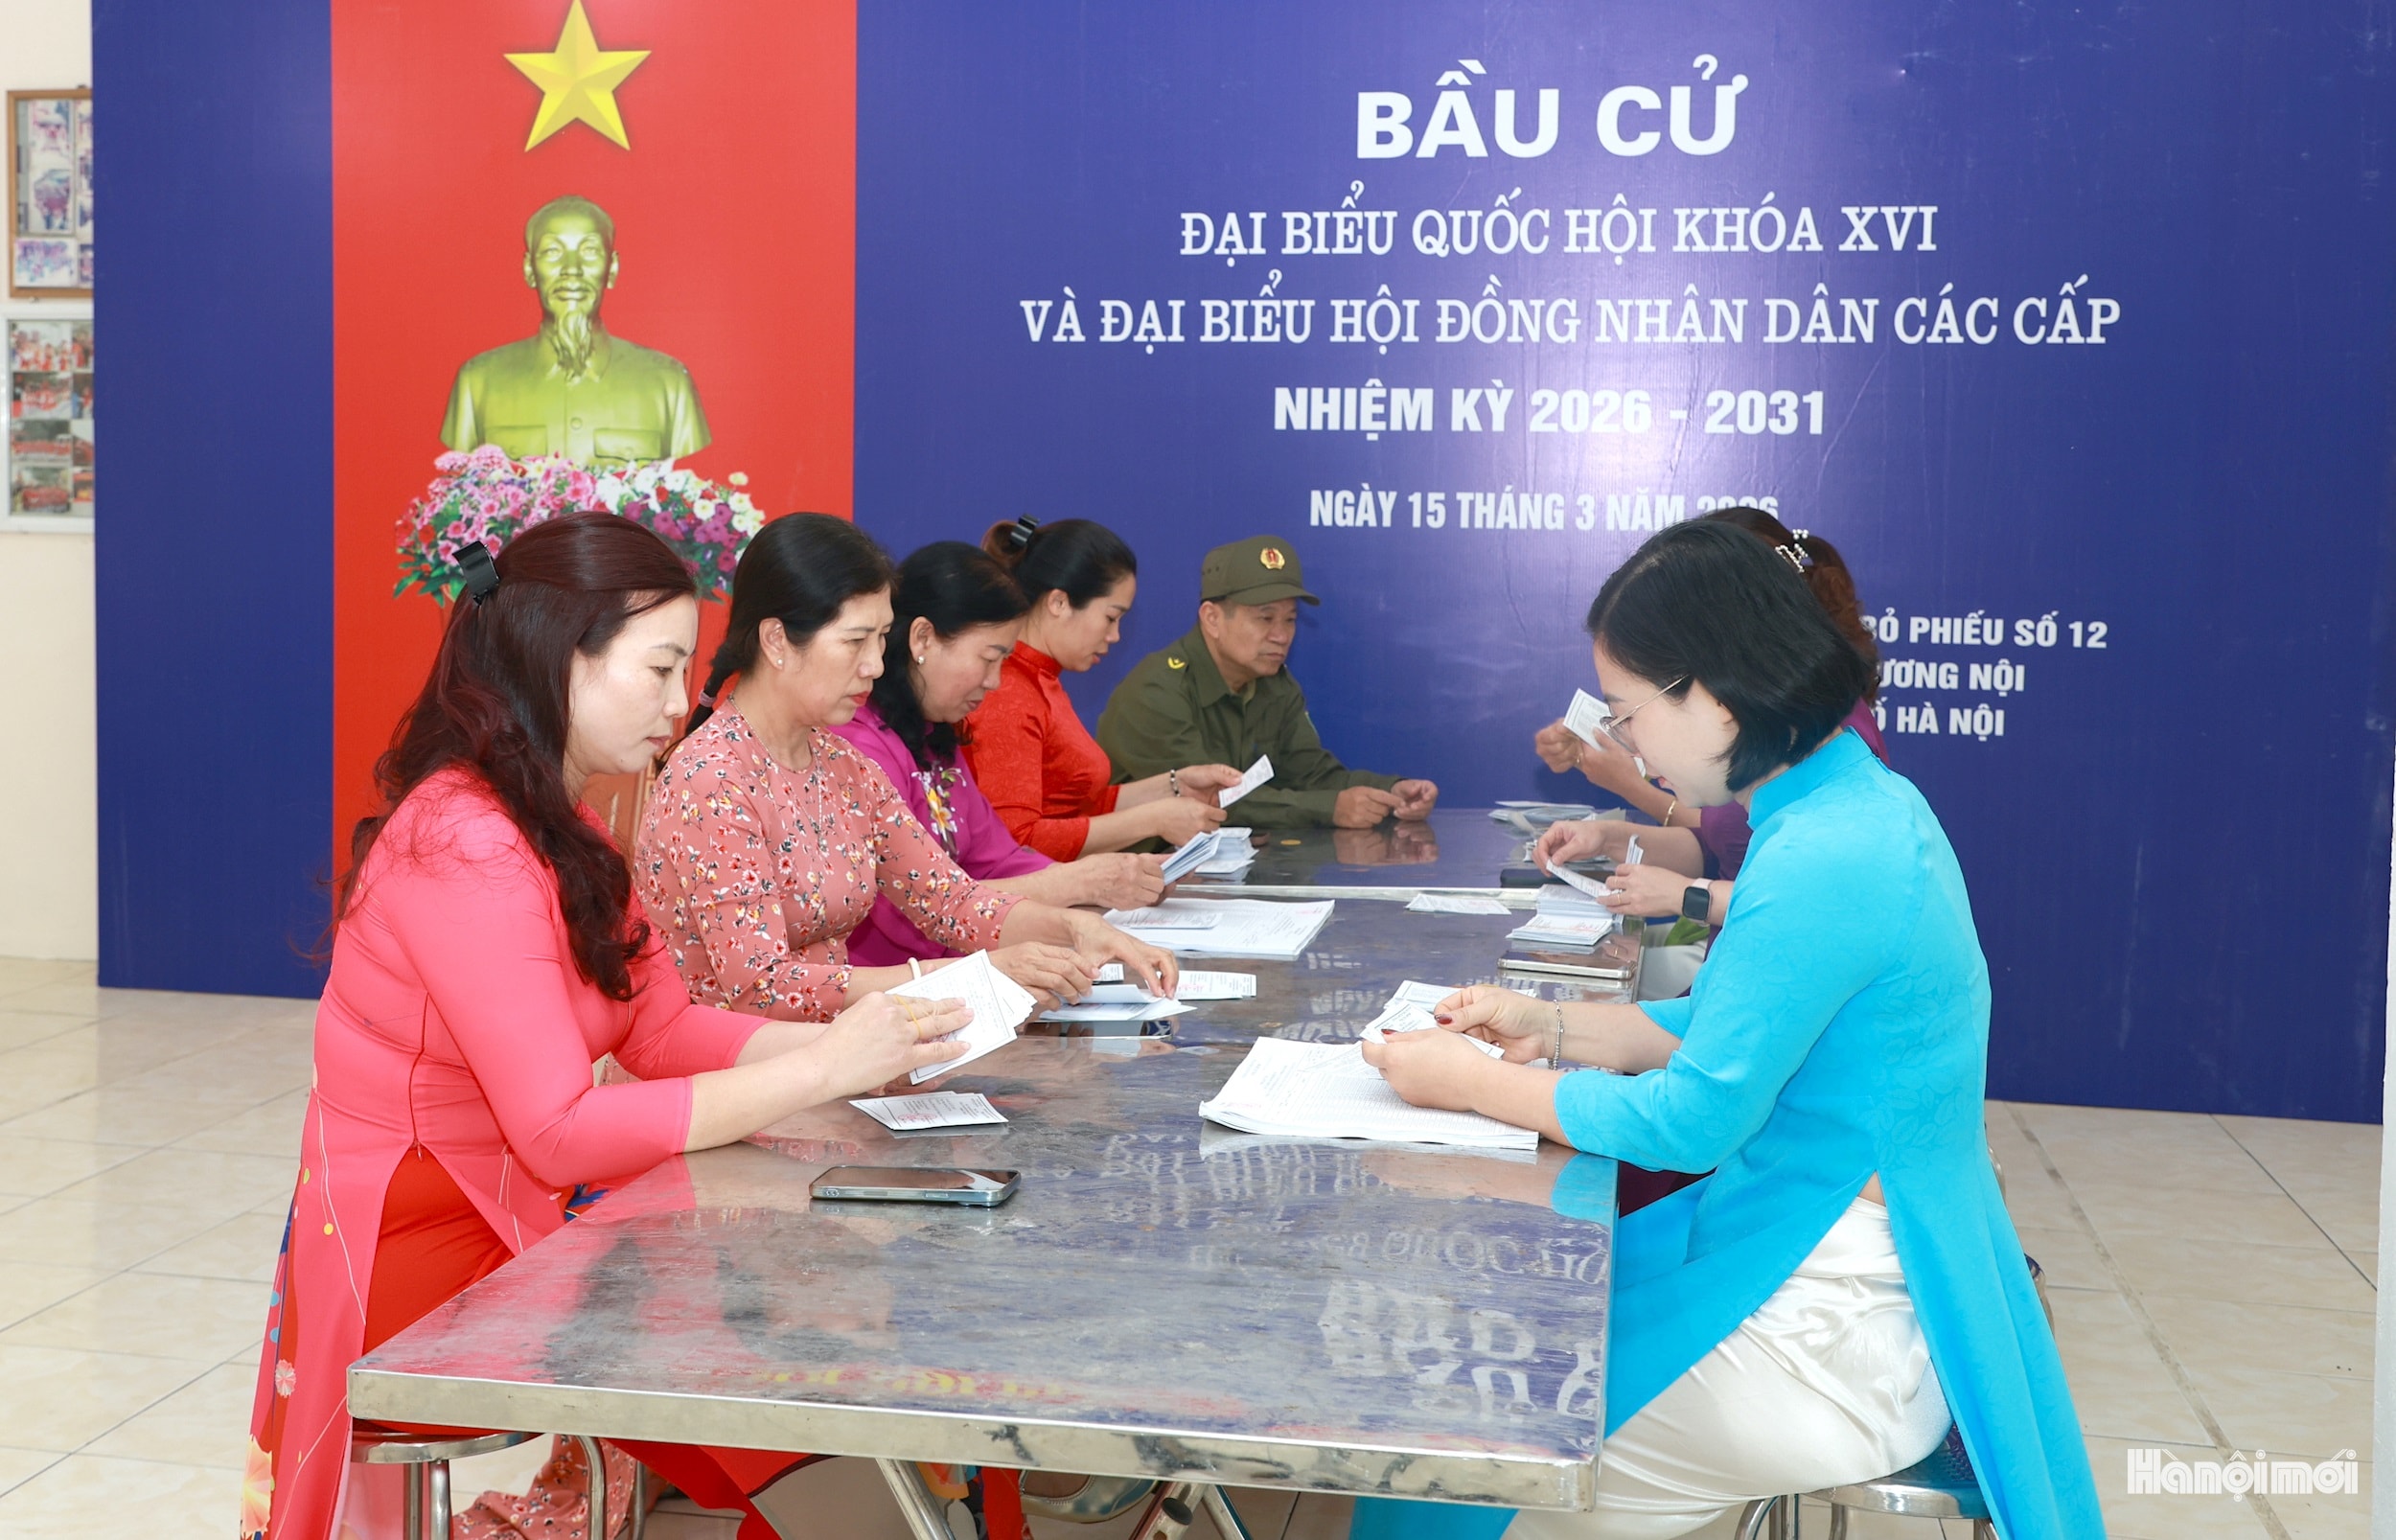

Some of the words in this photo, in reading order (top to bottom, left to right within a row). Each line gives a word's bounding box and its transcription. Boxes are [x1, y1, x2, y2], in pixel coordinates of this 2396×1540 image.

[1356, 58, 1560, 159] BẦU
[1596, 53, 1749, 157] CỬ
[1180, 212, 1267, 267] ĐẠI
[1280, 179, 1398, 256] BIỂU
[1412, 186, 1551, 258] QUỐC
[1562, 192, 1658, 265] HỘI
[1671, 191, 1824, 253] KHÓA
[1838, 206, 1938, 252] XVI
[1020, 286, 1086, 342] VÀ
[1099, 300, 1186, 355] ĐẠI
[1200, 268, 1316, 343] BIỂU
[1329, 284, 1420, 355] HỘI
[1435, 274, 1581, 344] ĐỒNG
[1594, 283, 1749, 344] NHÂN
[1762, 282, 1879, 344] DÂN
[1894, 282, 1998, 344] CÁC
[2014, 274, 2121, 344] CẤP
[1274, 379, 1435, 441] NHIỆM
[1450, 379, 1514, 432] KỲ
[1529, 388, 1652, 435] 2026
[1669, 407, 1689, 421] -
[1704, 389, 1824, 435] 2031
[1309, 482, 1398, 528] NGÀY
[1408, 492, 1446, 529] 15
[1455, 485, 1565, 531] THÁNG
[1576, 493, 1596, 531] 3
[1606, 487, 1685, 532] NĂM
[1909, 610, 2005, 646] PHIẾU
[2014, 610, 2059, 648] SỐ
[2069, 621, 2108, 649] 12
[1877, 657, 1959, 690] ƯƠNG
[1970, 658, 2025, 697] NỘI
[1896, 701, 1940, 735] HÀ
[1948, 703, 2005, 741] NỘI
